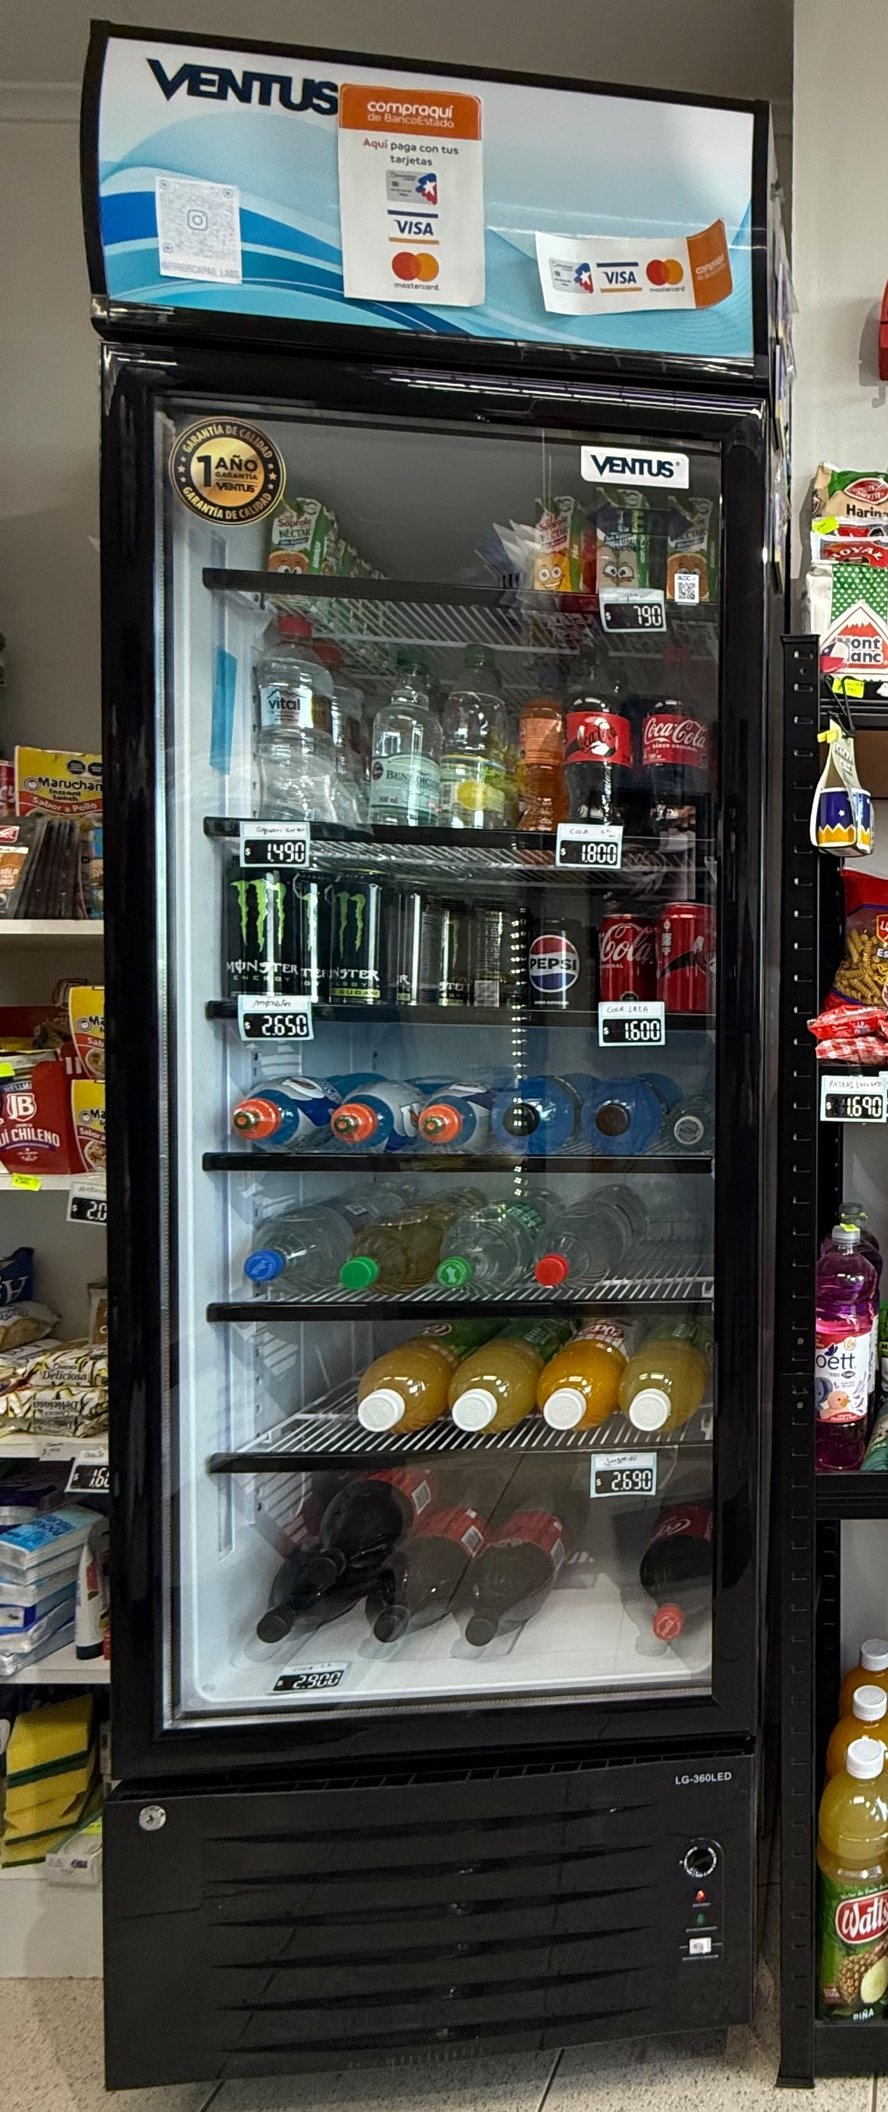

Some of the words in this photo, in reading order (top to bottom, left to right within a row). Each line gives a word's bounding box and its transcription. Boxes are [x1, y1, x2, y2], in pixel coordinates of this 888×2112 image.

[147, 59, 338, 116] VENTUS
[367, 101, 454, 119] compraquí
[368, 113, 382, 122] de
[384, 113, 455, 128] BancoEstado
[363, 138, 388, 150] Aquí
[390, 142, 417, 153] paga
[419, 145, 439, 153] con
[441, 146, 459, 155] tus
[390, 155, 433, 166] tarjetas
[394, 219, 434, 236] VISA
[394, 281, 439, 291] mastercard
[602, 271, 637, 285] VISA
[183, 424, 224, 453] GARANTÍA
[225, 425, 238, 436] DE
[239, 428, 273, 459] CALIDAD
[196, 455, 212, 488] 1
[215, 454, 258, 472] AÑO
[590, 455, 674, 478] VENTUS
[215, 482, 256, 493] VENTUS
[182, 486, 224, 519] GARANTÍA
[225, 510, 238, 520] DE
[238, 492, 272, 518] CALIDAD
[633, 605, 662, 626] 790
[268, 697, 300, 710] vital
[644, 717, 707, 748] Coca-Cola
[38, 776, 104, 791] Maruchan
[32, 796, 62, 811] Sabor
[72, 802, 97, 812] Pollo
[267, 842, 305, 862] 1.490
[581, 843, 617, 864] 1.800
[530, 957, 577, 970] PEPSI
[261, 1015, 308, 1036] 2.650
[624, 1020, 660, 1041] 1.600
[846, 1096, 882, 1118] 1.690
[11, 1127, 60, 1148] CHILENO
[86, 1201, 107, 1221] 2.0
[43, 1370, 87, 1381] Deliciosa
[611, 1471, 652, 1491] 2.690
[292, 1672, 341, 1689] 2.900
[675, 1772, 733, 1785] LG-360LED
[852, 2007, 875, 2021] PIÑA
